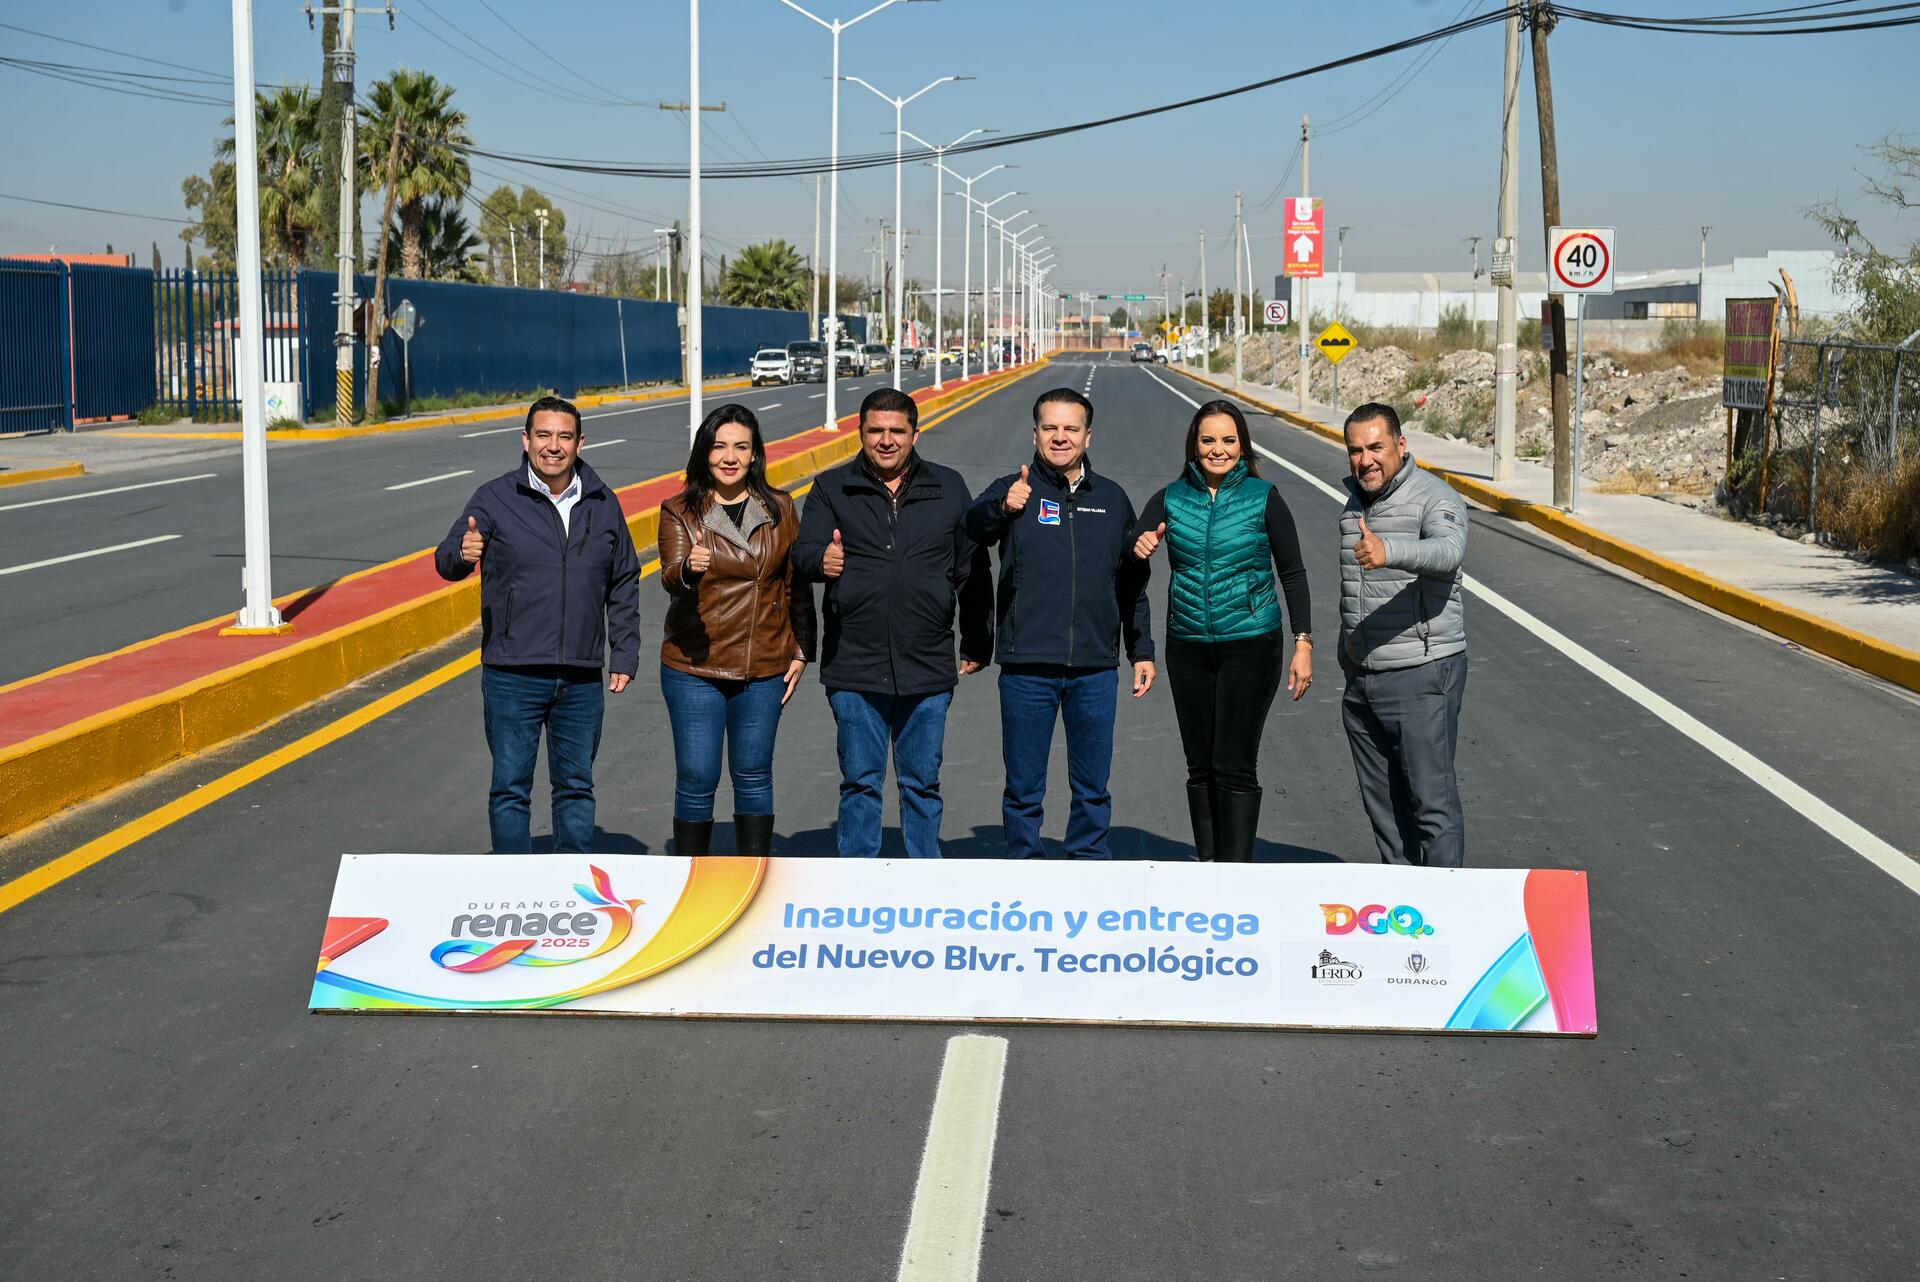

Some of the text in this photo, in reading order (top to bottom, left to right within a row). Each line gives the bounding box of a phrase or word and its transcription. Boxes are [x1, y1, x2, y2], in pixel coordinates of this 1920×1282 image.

[1566, 244, 1597, 268] 40
[467, 900, 577, 910] DURANGO
[450, 912, 598, 938] renace
[783, 900, 1259, 941] Inauguración y entrega
[540, 938, 591, 948] 2025
[752, 943, 1259, 982] del Nuevo Blvr. Tecnológico
[1310, 964, 1363, 980] LERDO
[1387, 977, 1448, 986] DURANGO
